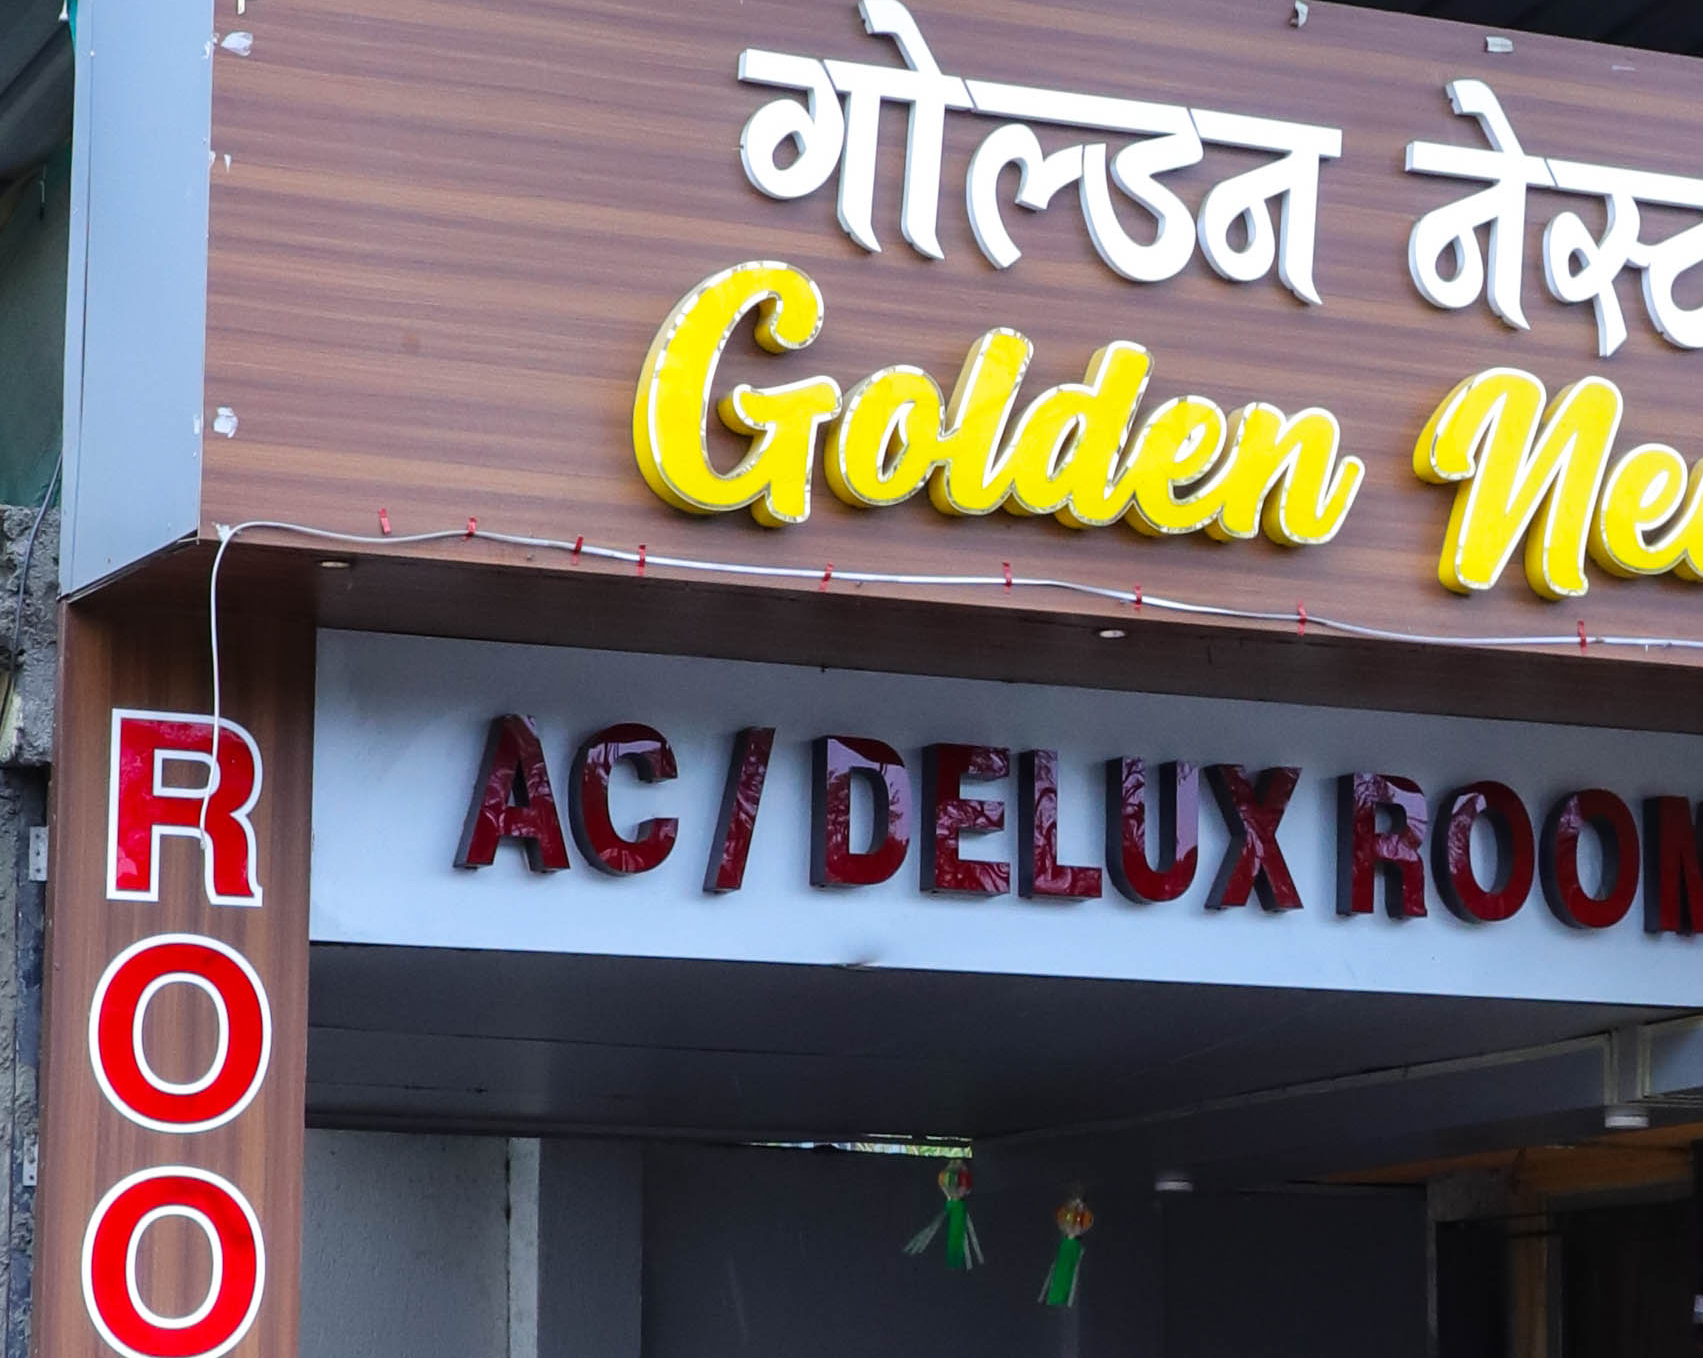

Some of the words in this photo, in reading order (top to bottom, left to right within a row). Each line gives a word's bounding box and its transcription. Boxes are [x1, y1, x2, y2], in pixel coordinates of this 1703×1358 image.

[633, 260, 1366, 547] Golden
[453, 713, 678, 877] AC
[810, 735, 1303, 912] DELUX
